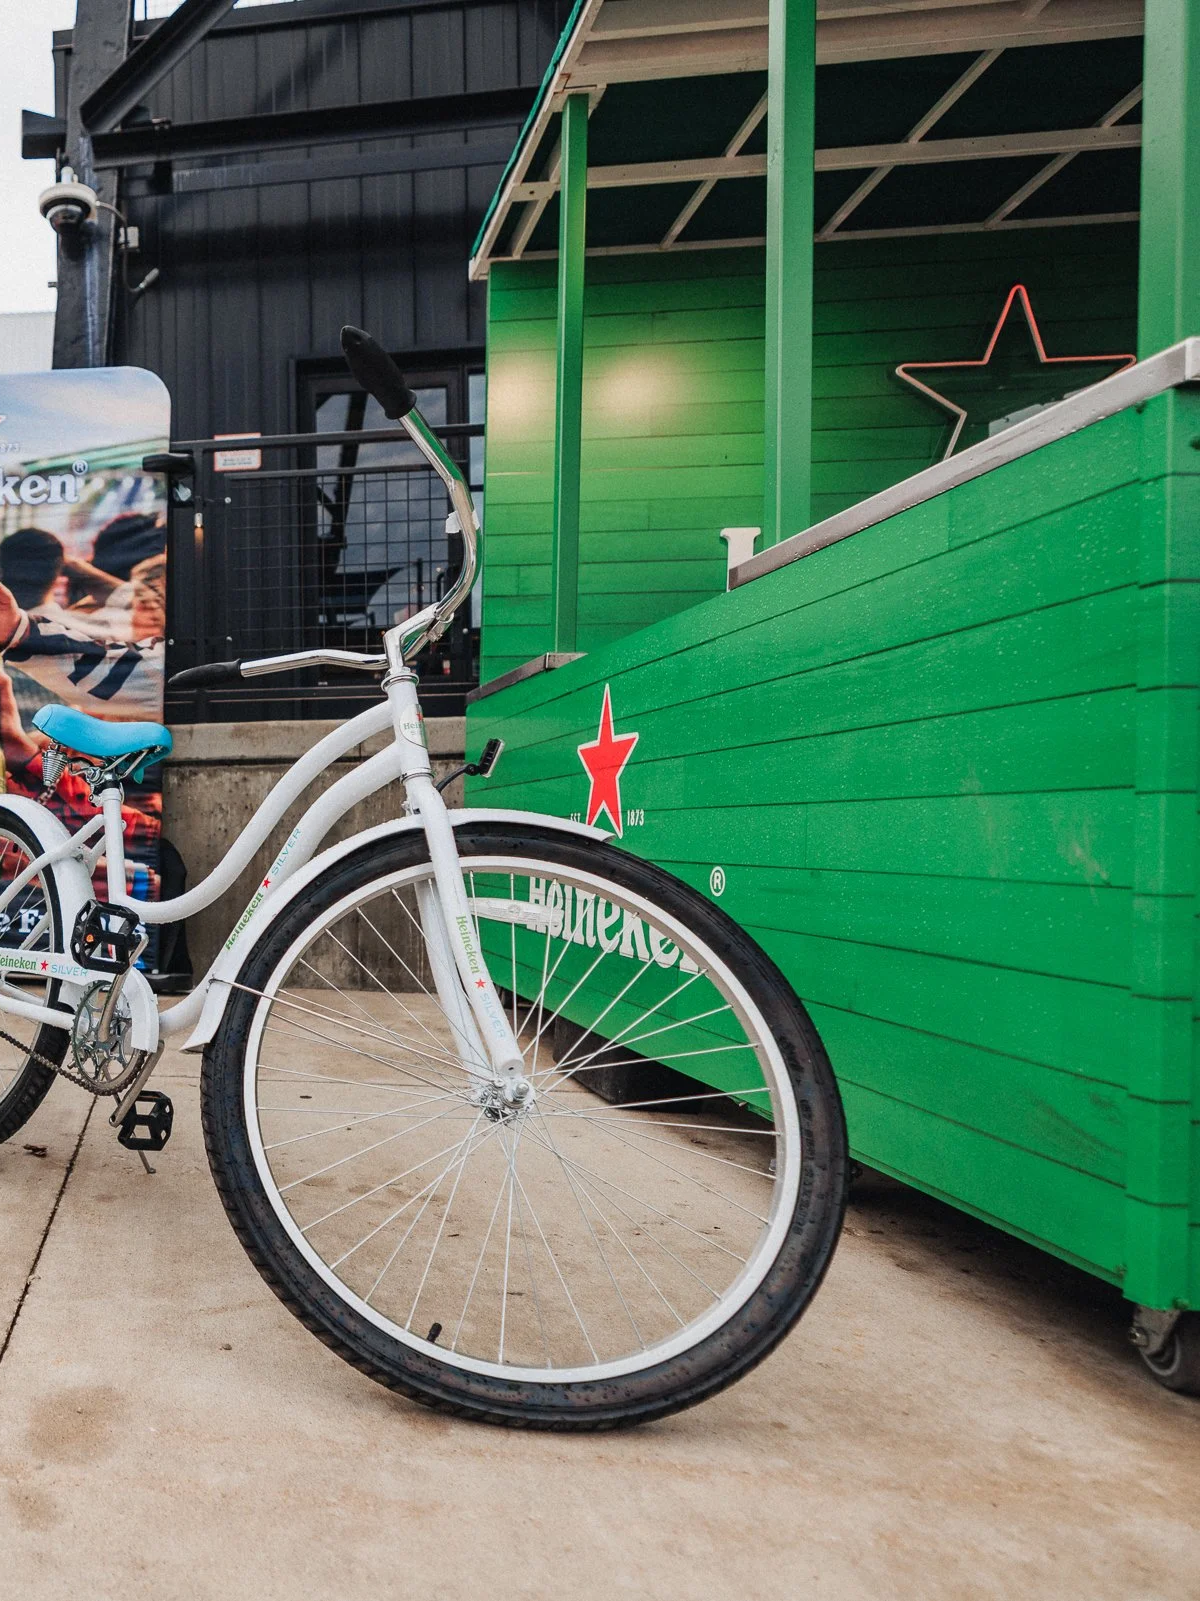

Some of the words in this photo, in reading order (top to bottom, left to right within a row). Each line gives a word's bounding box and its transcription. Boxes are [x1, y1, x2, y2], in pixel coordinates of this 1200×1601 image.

[627, 809, 645, 826] 1873
[225, 892, 264, 951] Heineken
[271, 828, 301, 876] SILVER
[51, 964, 89, 977] SILVER
[456, 915, 480, 974] Heineken
[480, 992, 506, 1039] SILVER
